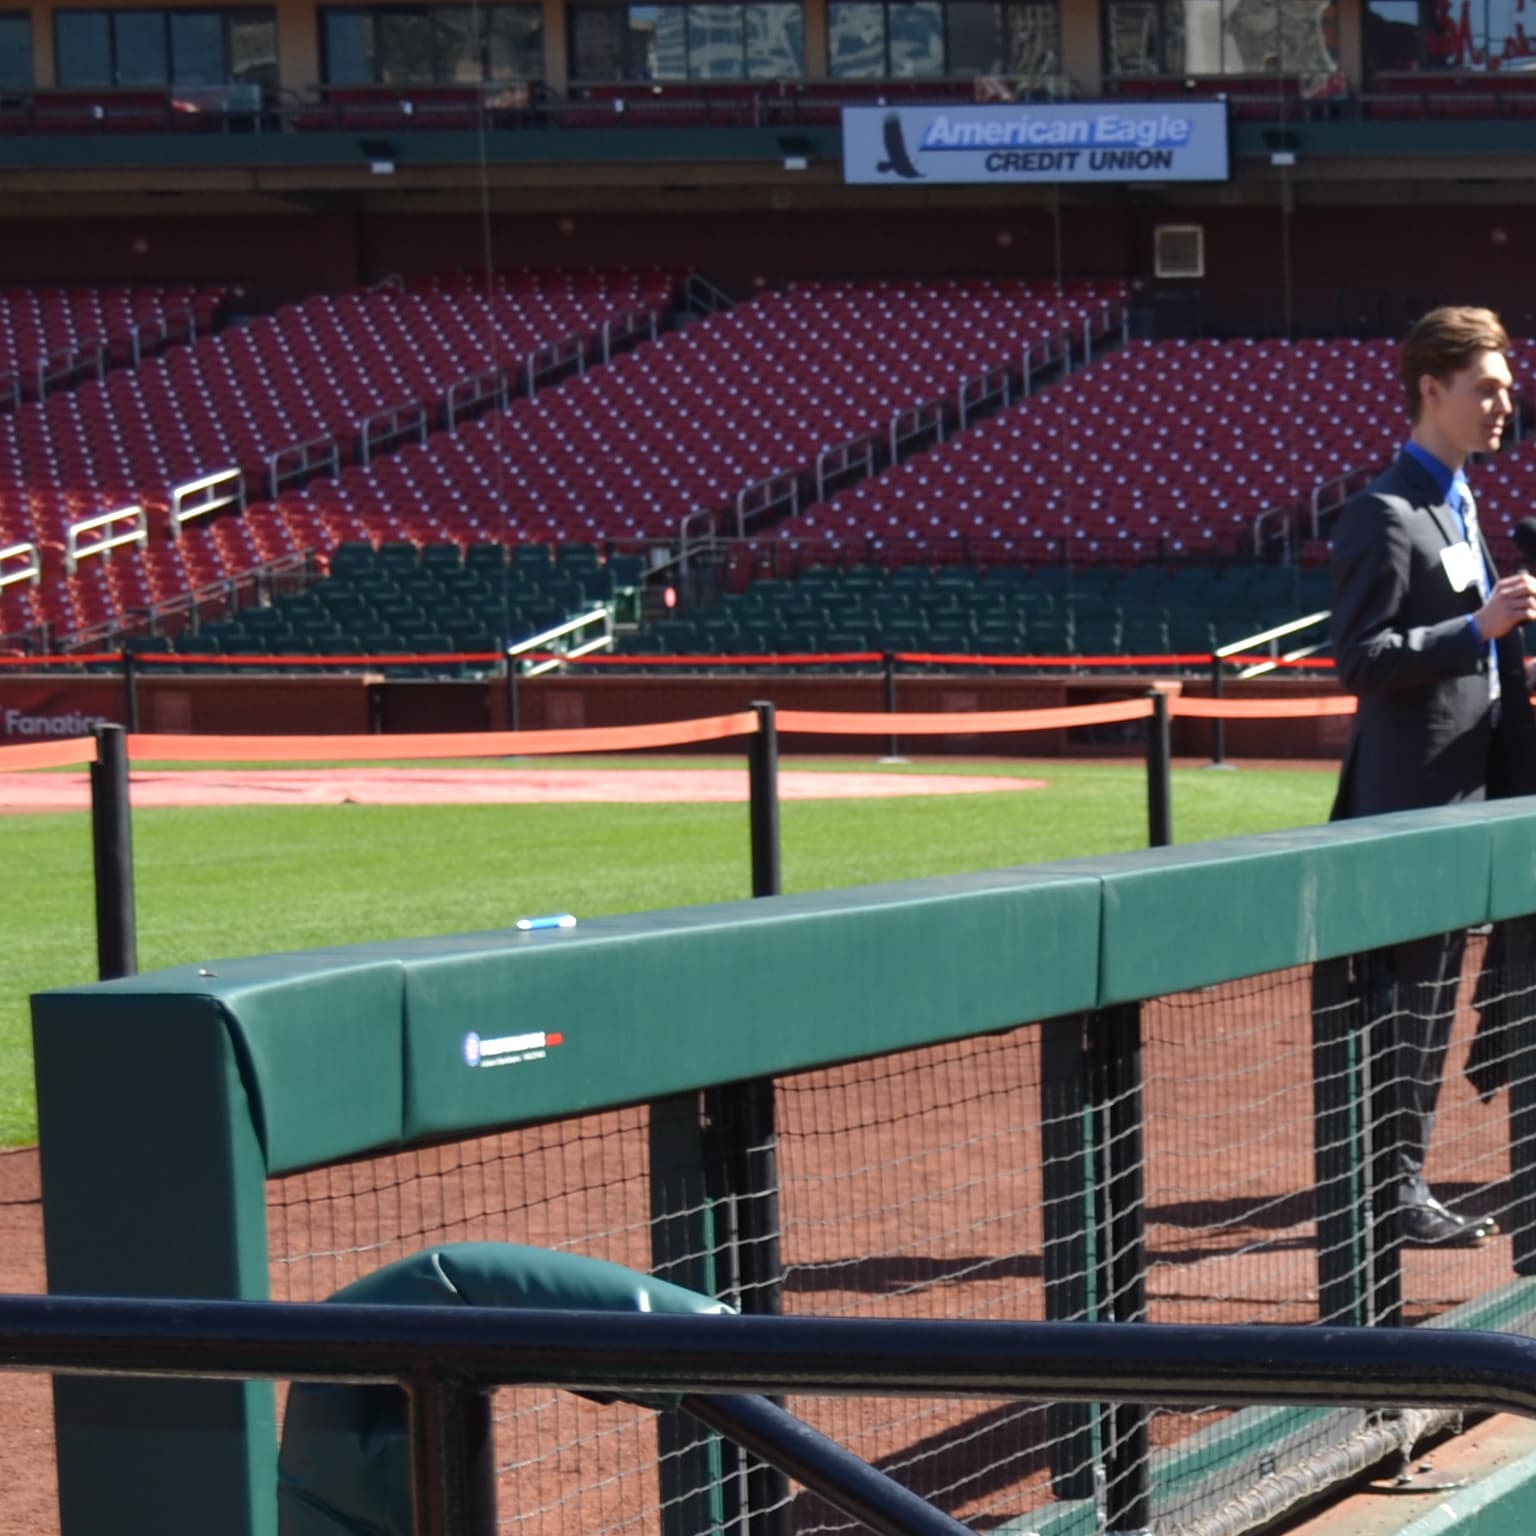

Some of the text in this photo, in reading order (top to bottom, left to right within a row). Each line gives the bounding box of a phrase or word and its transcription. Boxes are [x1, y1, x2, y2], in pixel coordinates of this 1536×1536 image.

[924, 114, 1191, 147] American Eagle
[984, 149, 1174, 173] CREDIT UNION
